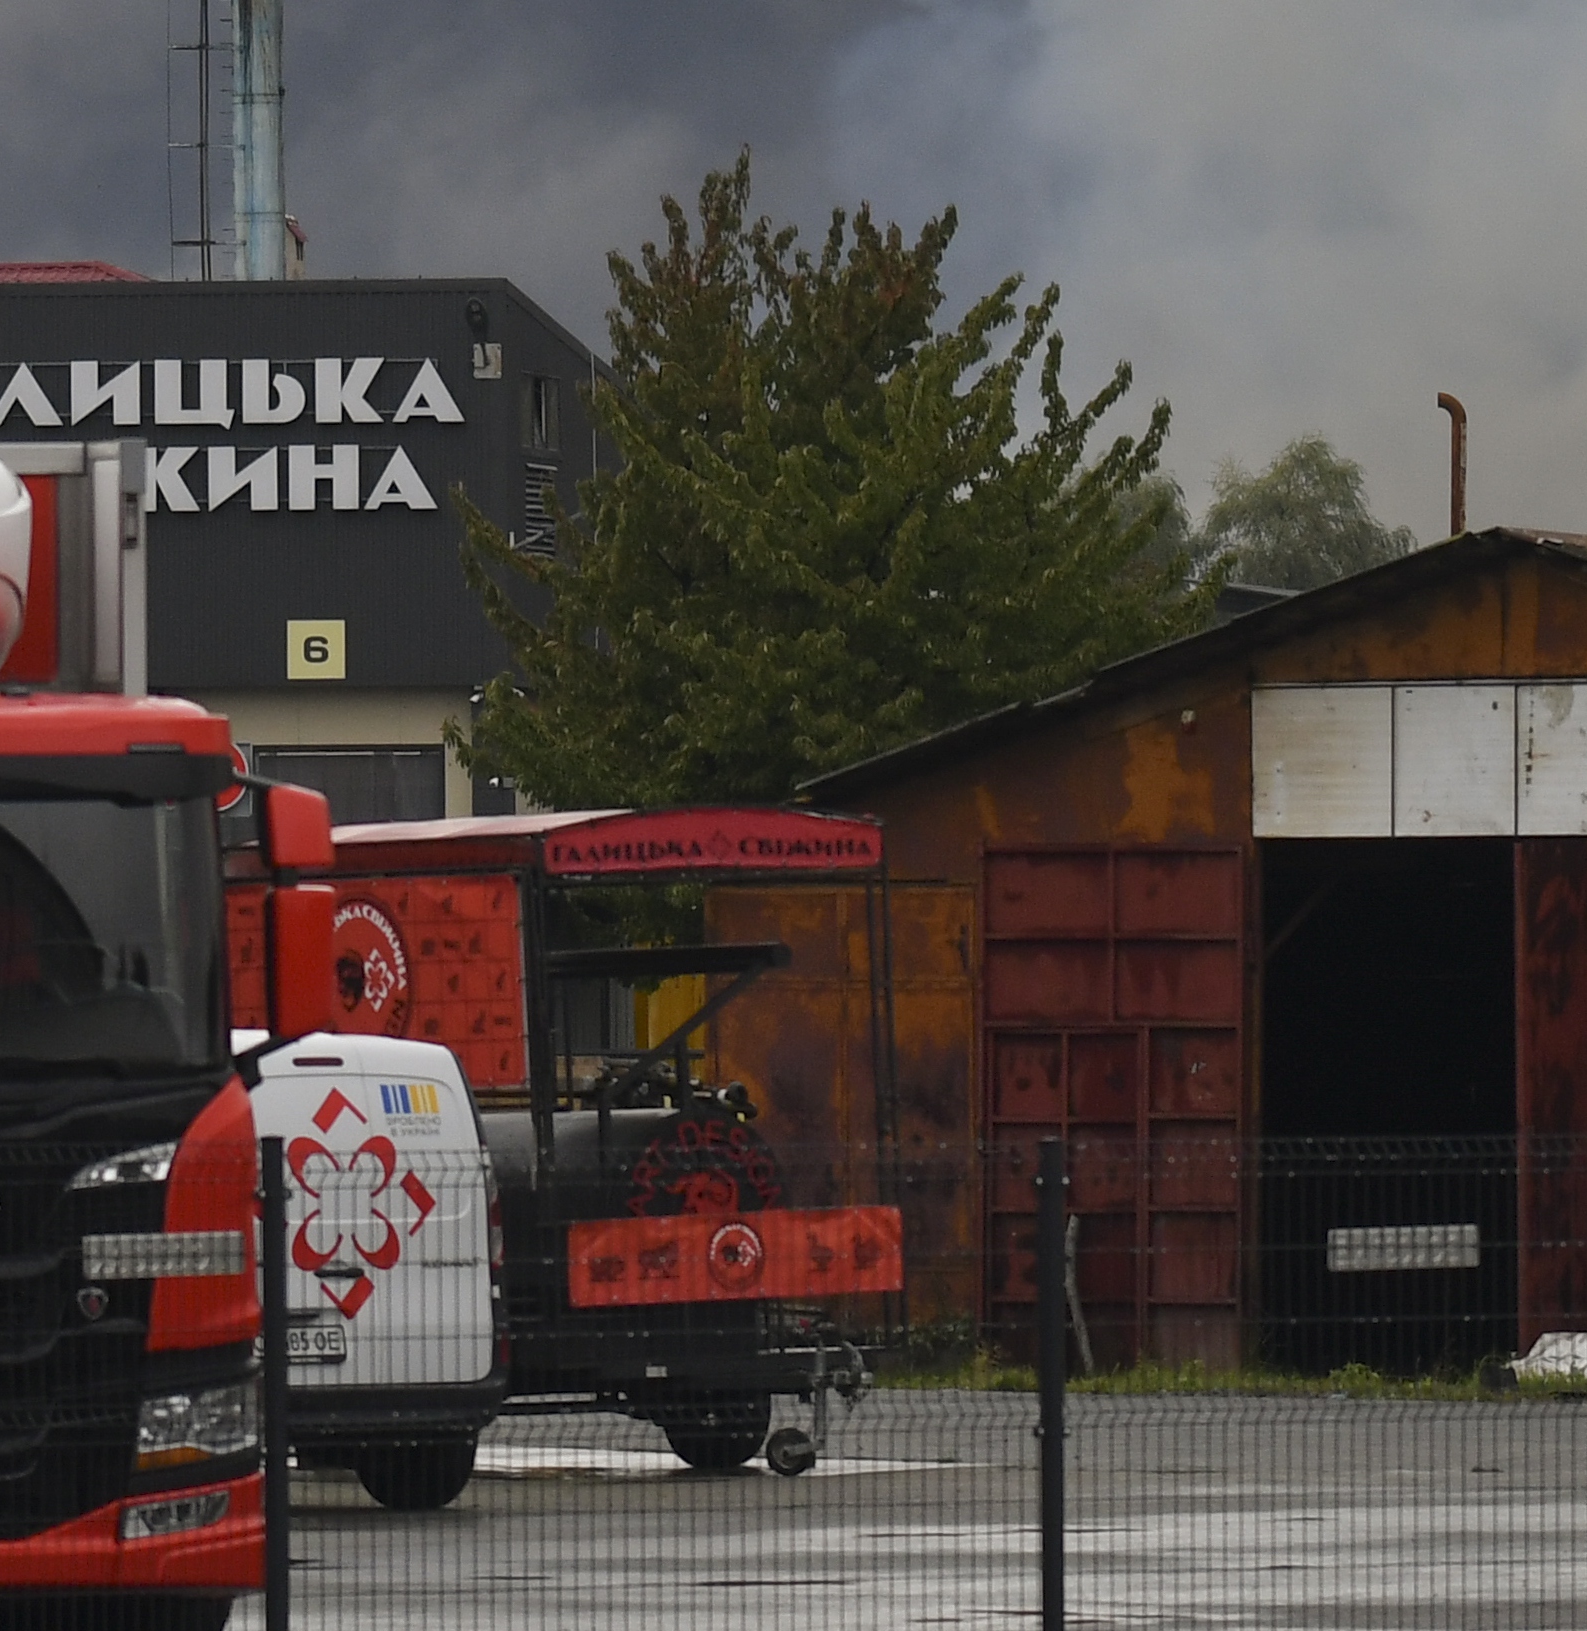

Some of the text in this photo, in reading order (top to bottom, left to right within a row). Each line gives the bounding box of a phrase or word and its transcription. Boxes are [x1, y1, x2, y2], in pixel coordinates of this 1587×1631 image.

[303, 636, 330, 664] 6
[551, 838, 871, 864] ГАЛИЦЬКА СВІЖИНА
